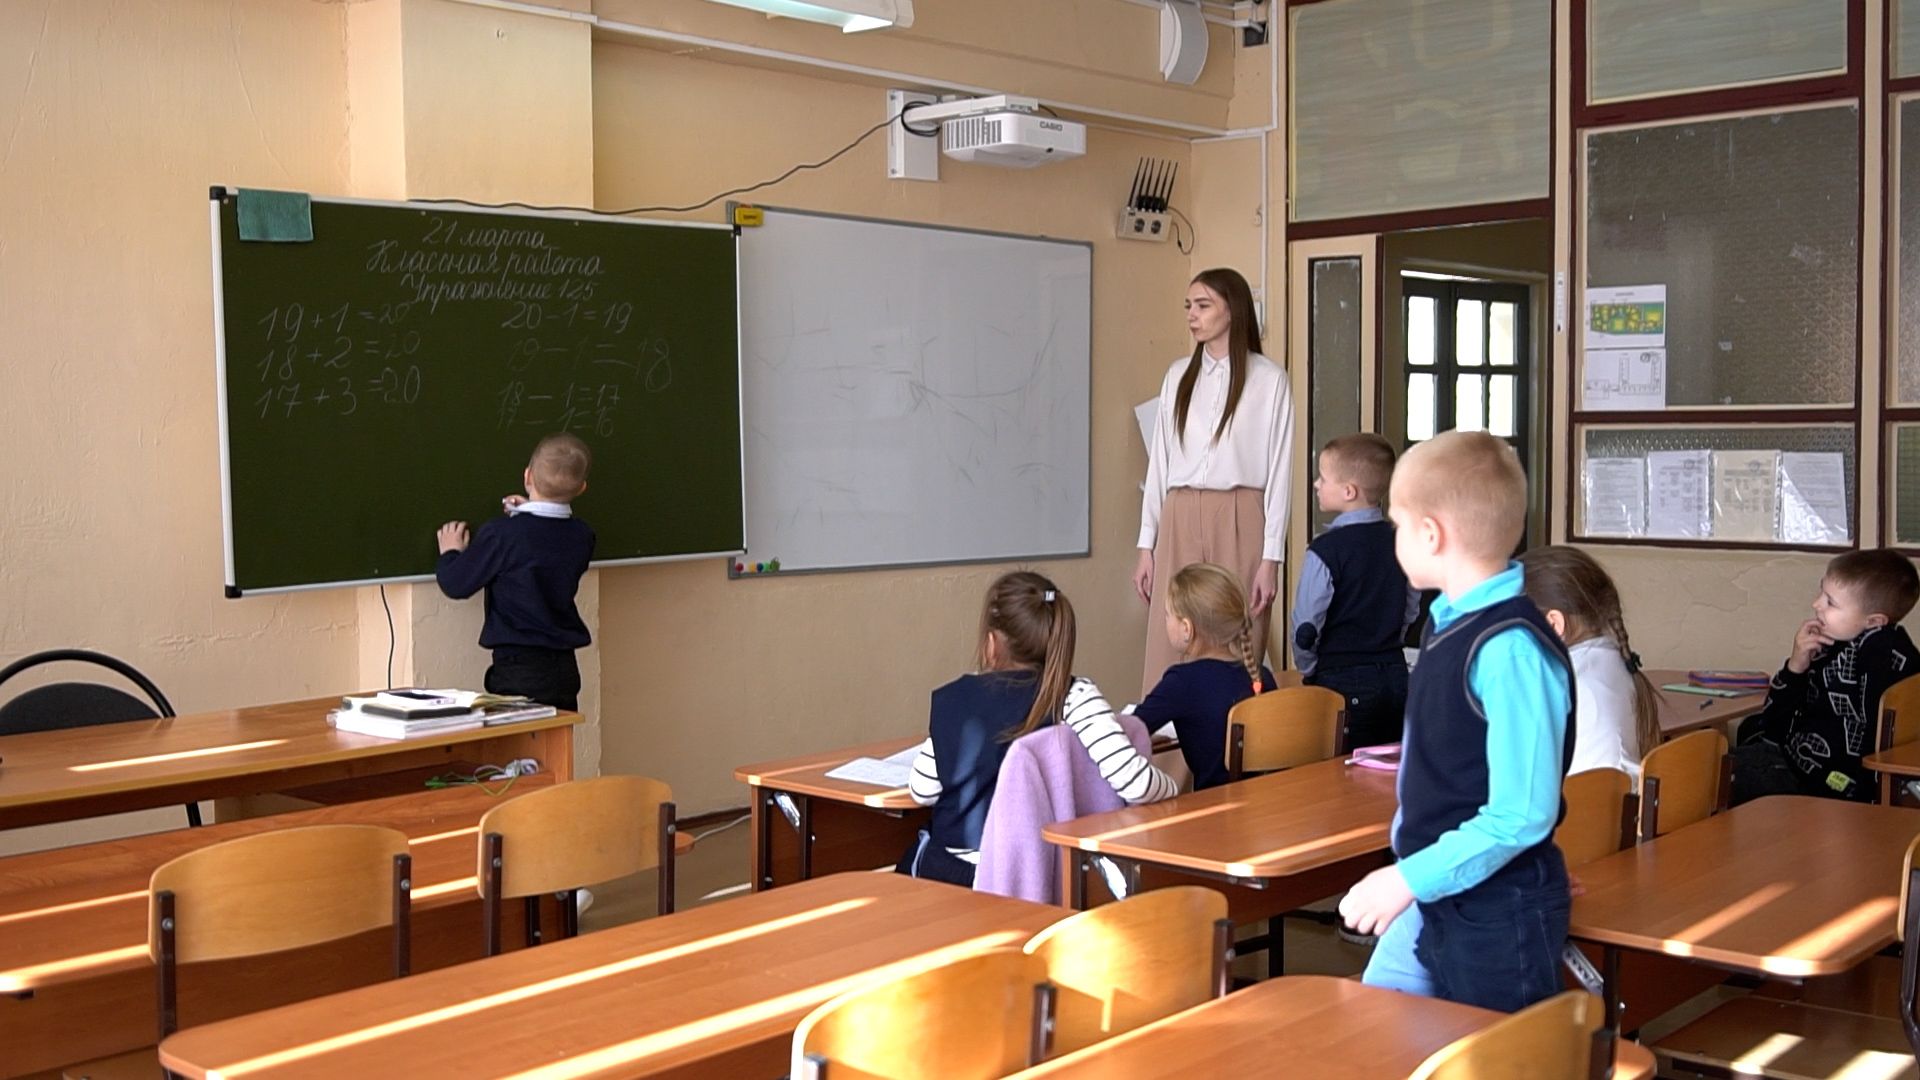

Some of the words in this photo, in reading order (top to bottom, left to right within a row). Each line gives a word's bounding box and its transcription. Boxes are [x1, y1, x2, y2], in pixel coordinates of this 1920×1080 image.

[1039, 120, 1064, 132] CASIO
[422, 217, 457, 245] 21
[460, 227, 556, 253] марта
[367, 240, 501, 273] Классная
[499, 247, 605, 283] работа
[559, 279, 598, 300] 125
